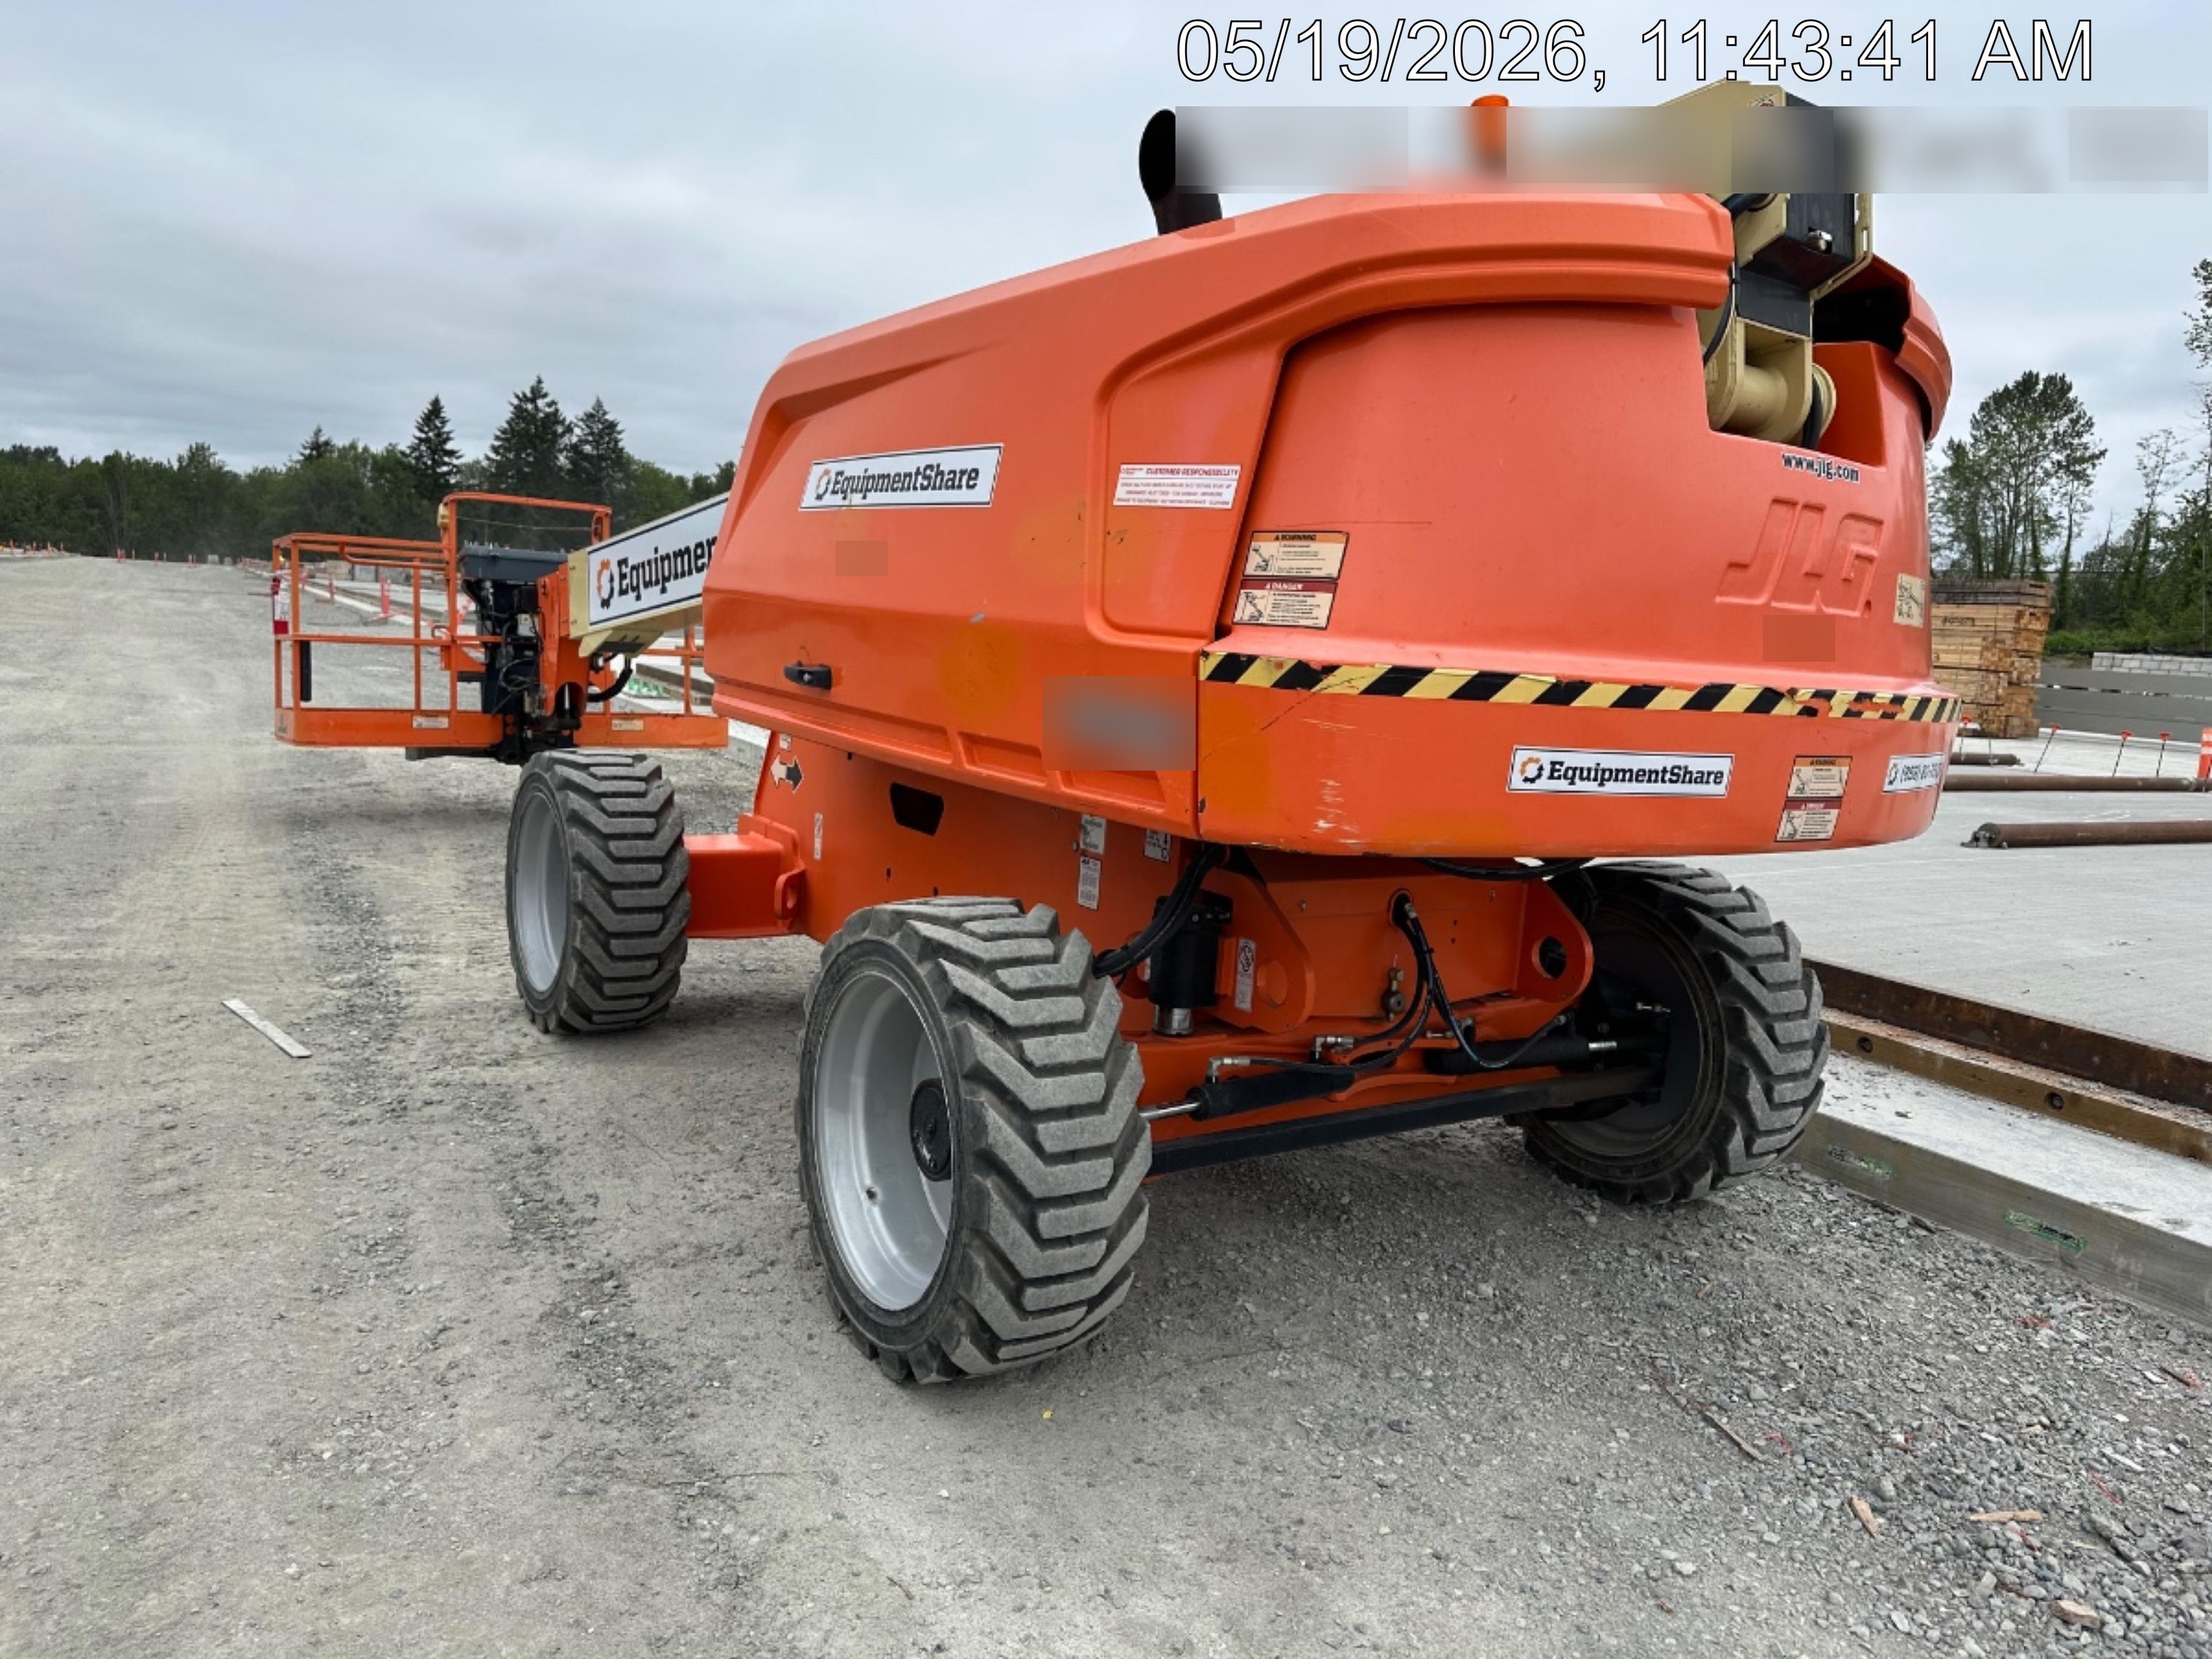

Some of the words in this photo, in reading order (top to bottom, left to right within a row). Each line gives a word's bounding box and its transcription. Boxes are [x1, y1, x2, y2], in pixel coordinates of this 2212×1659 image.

[831, 463, 979, 500] EquipmentShare
[1782, 453, 1859, 482] www.jlg.com
[1714, 498, 1885, 617] JLG
[1547, 760, 1724, 786] EquipmentShare
